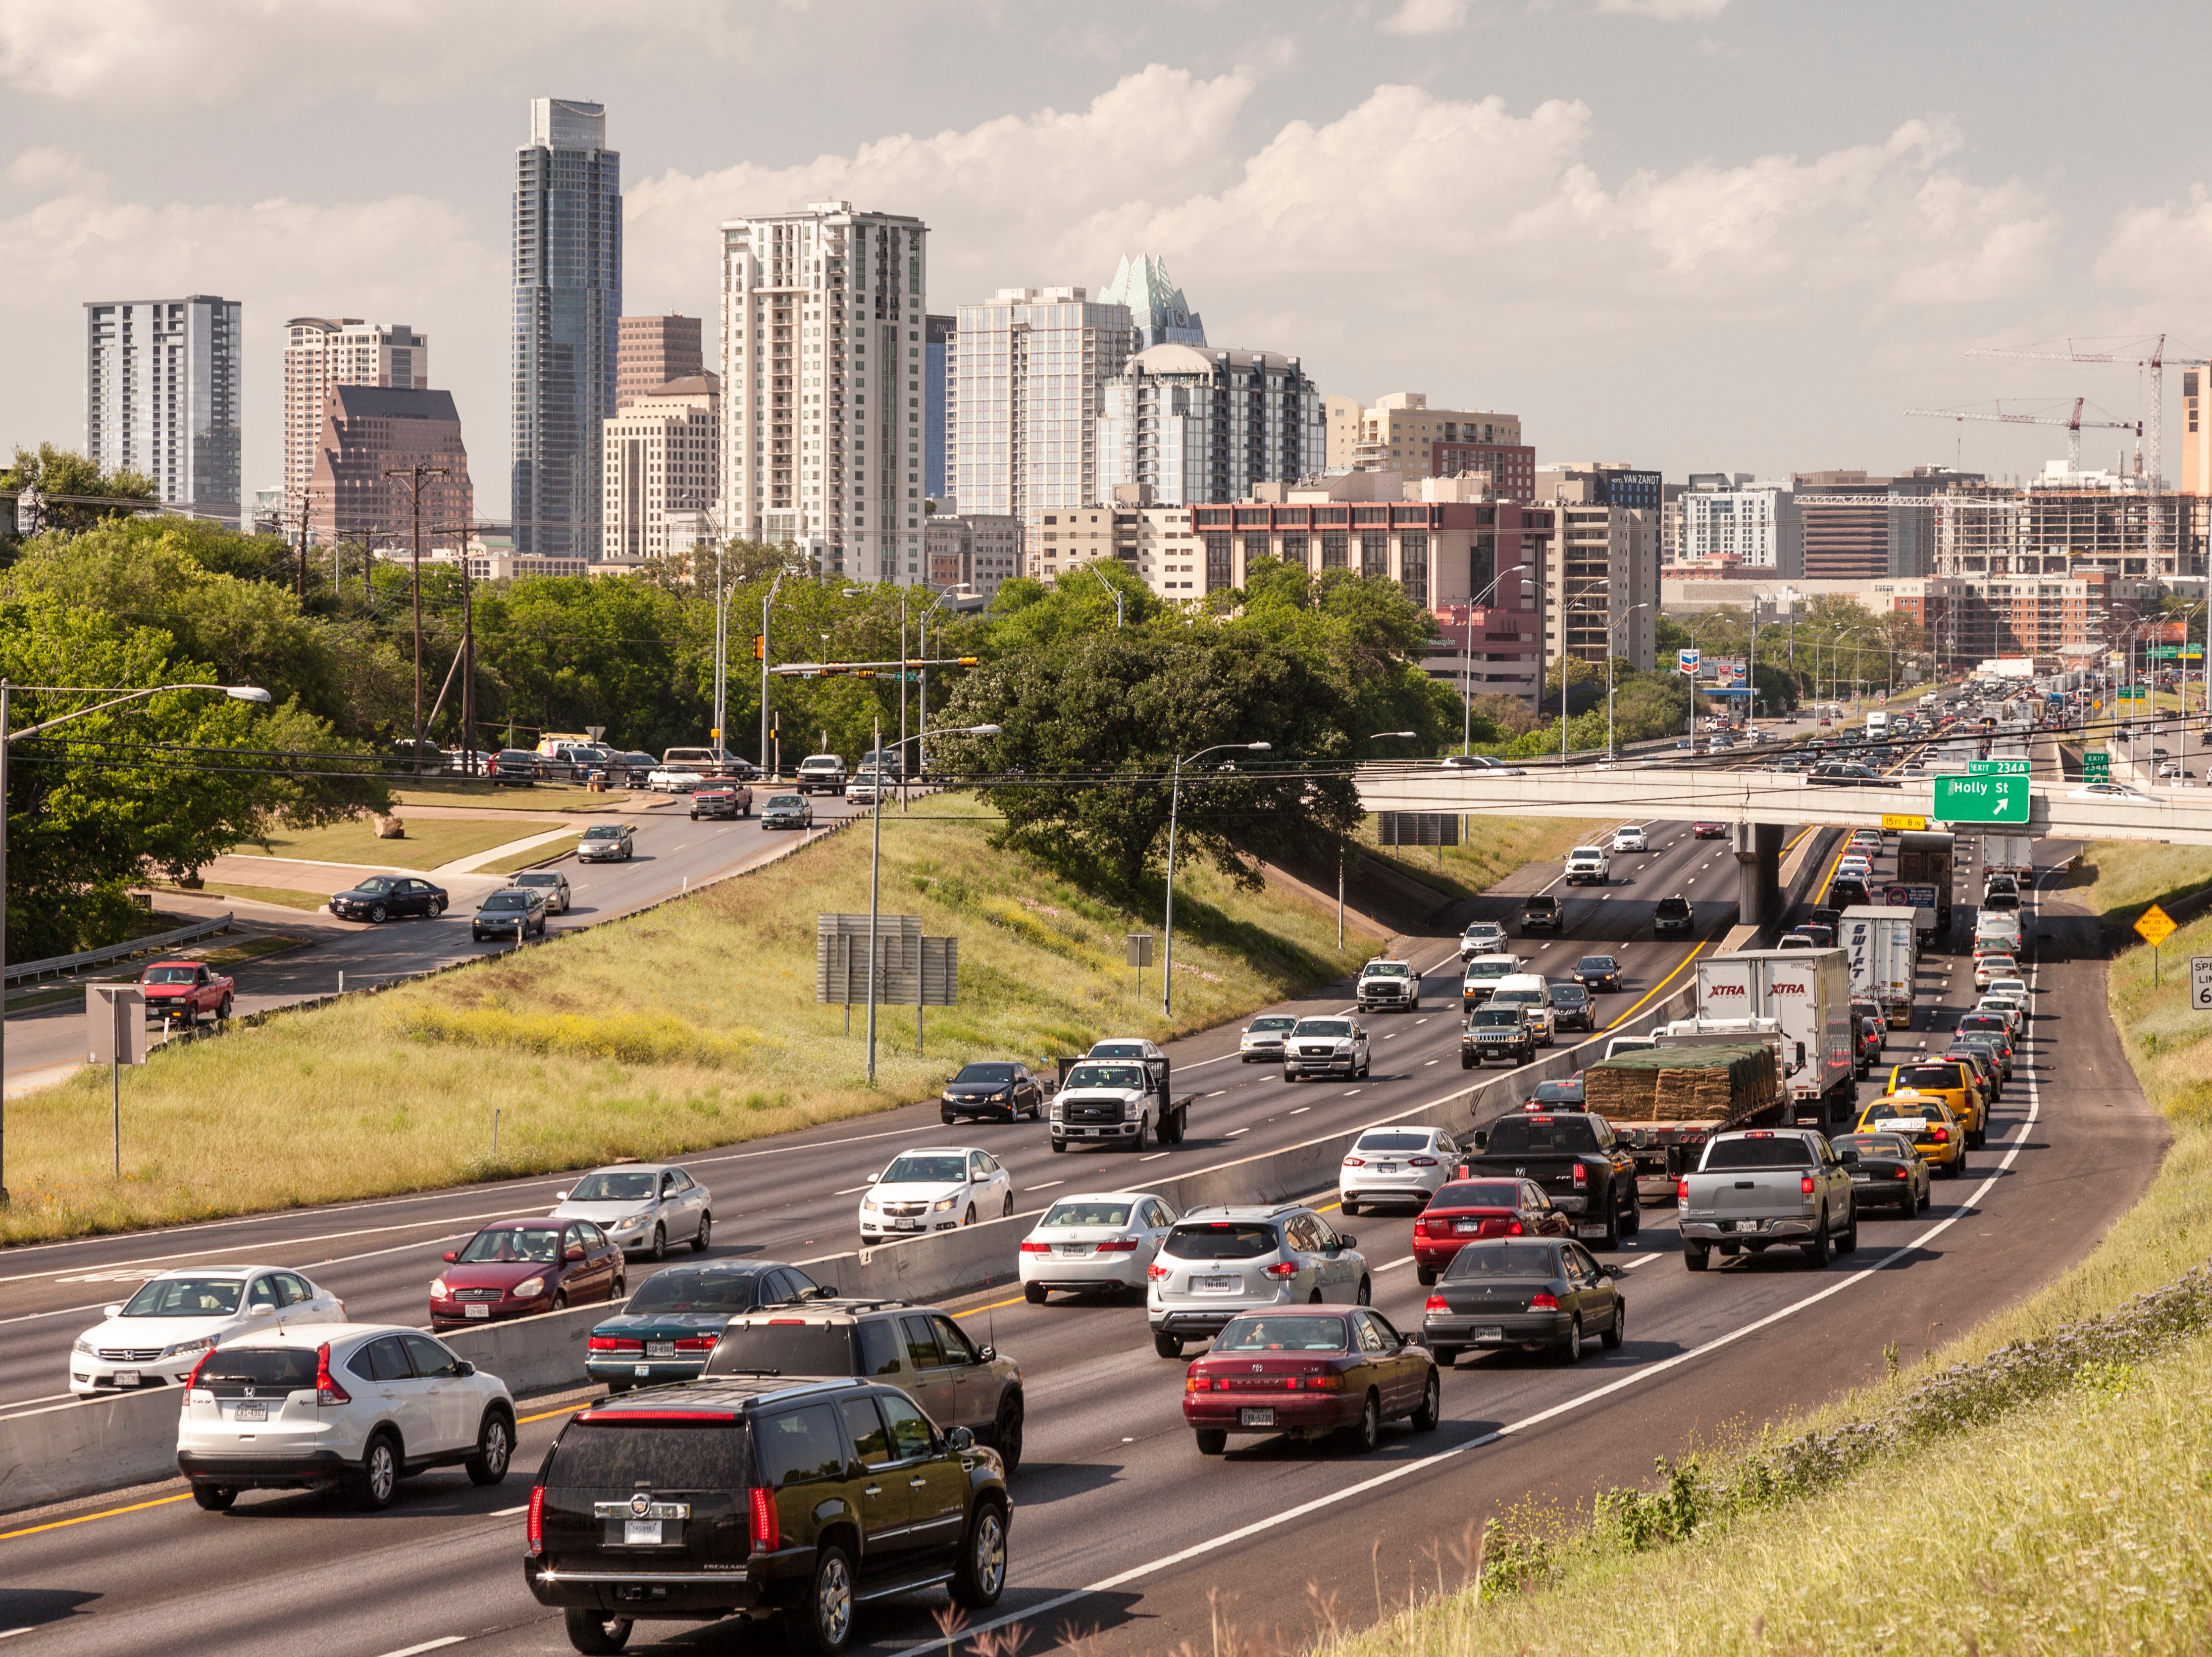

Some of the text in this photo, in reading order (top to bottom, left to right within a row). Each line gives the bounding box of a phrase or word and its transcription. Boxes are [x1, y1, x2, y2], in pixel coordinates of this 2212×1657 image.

[1624, 474, 1637, 484] VAN
[1638, 475, 1659, 484] ZANDT
[1428, 637, 1455, 647] Holiday Inn
[1997, 763, 2025, 773] 234A
[1955, 782, 2008, 795] Holly St
[1851, 924, 1866, 978] SWIFT
[1708, 984, 1745, 998] XTRA
[1767, 983, 1805, 997] XTRA
